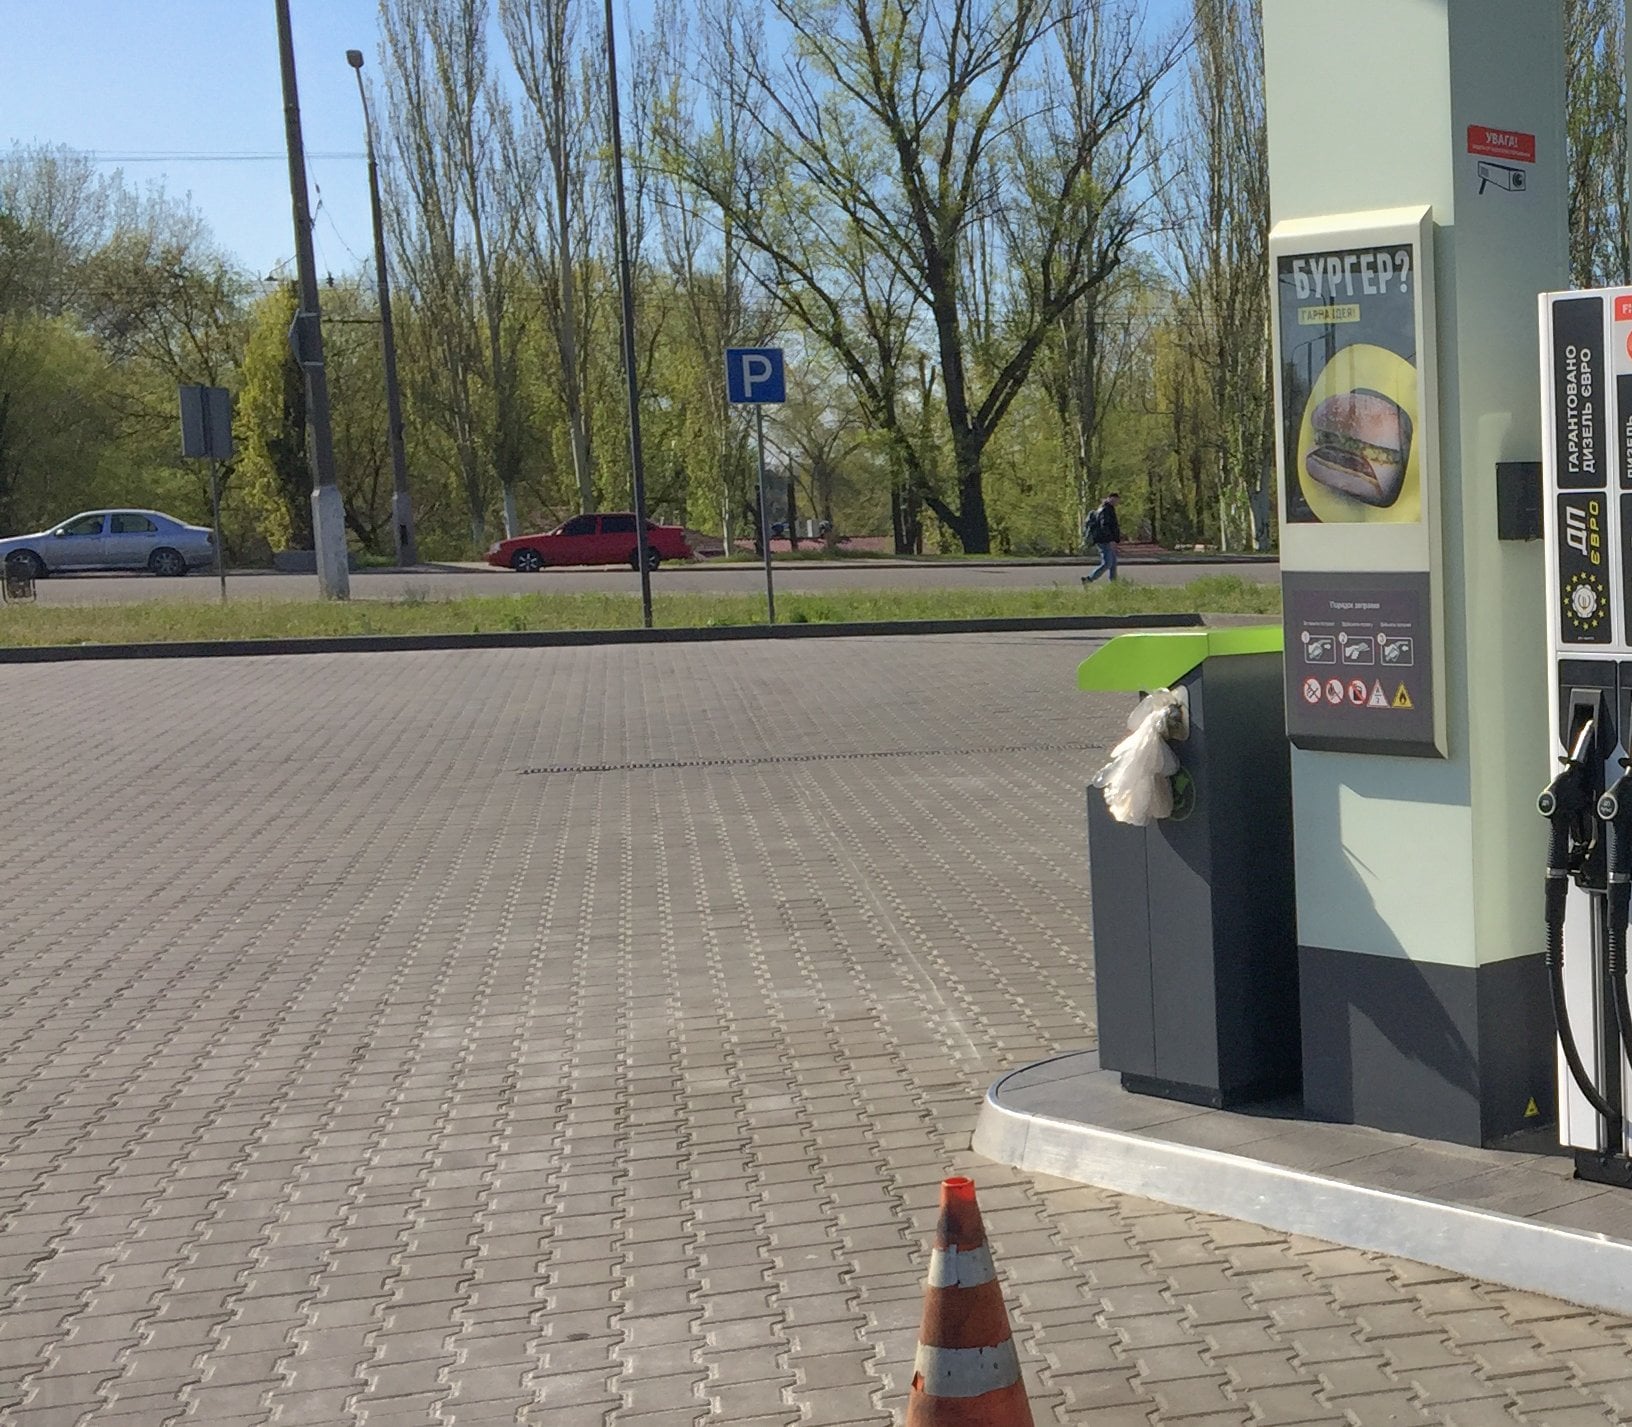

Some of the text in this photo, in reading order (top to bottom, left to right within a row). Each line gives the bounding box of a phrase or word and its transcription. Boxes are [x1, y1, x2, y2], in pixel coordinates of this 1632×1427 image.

[1485, 131, 1518, 148] УВАГА!
[1292, 250, 1410, 300] БУРГЕР?
[742, 354, 772, 398] P
[1566, 345, 1580, 473] ГАРАНТОВАНО
[1580, 348, 1596, 474] ДИЗЕЛЬ ЄВРО
[1566, 506, 1588, 556] ДП
[1589, 500, 1601, 565] ЄВРО
